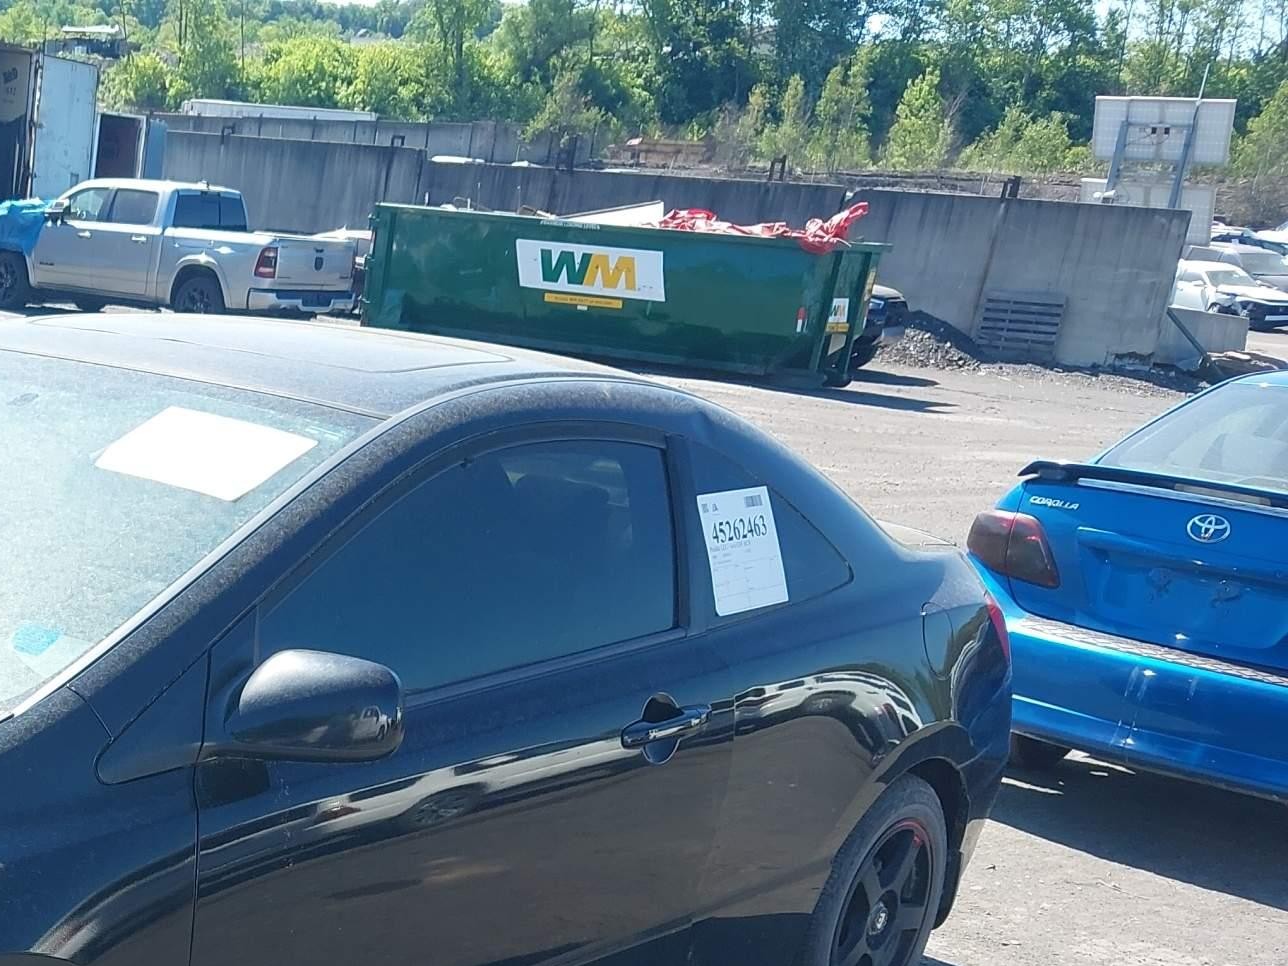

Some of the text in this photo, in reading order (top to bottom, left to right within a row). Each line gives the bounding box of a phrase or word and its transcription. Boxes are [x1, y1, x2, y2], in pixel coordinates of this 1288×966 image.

[540, 248, 637, 292] WM
[1029, 495, 1080, 510] COROLLA
[712, 515, 767, 544] 45262463
